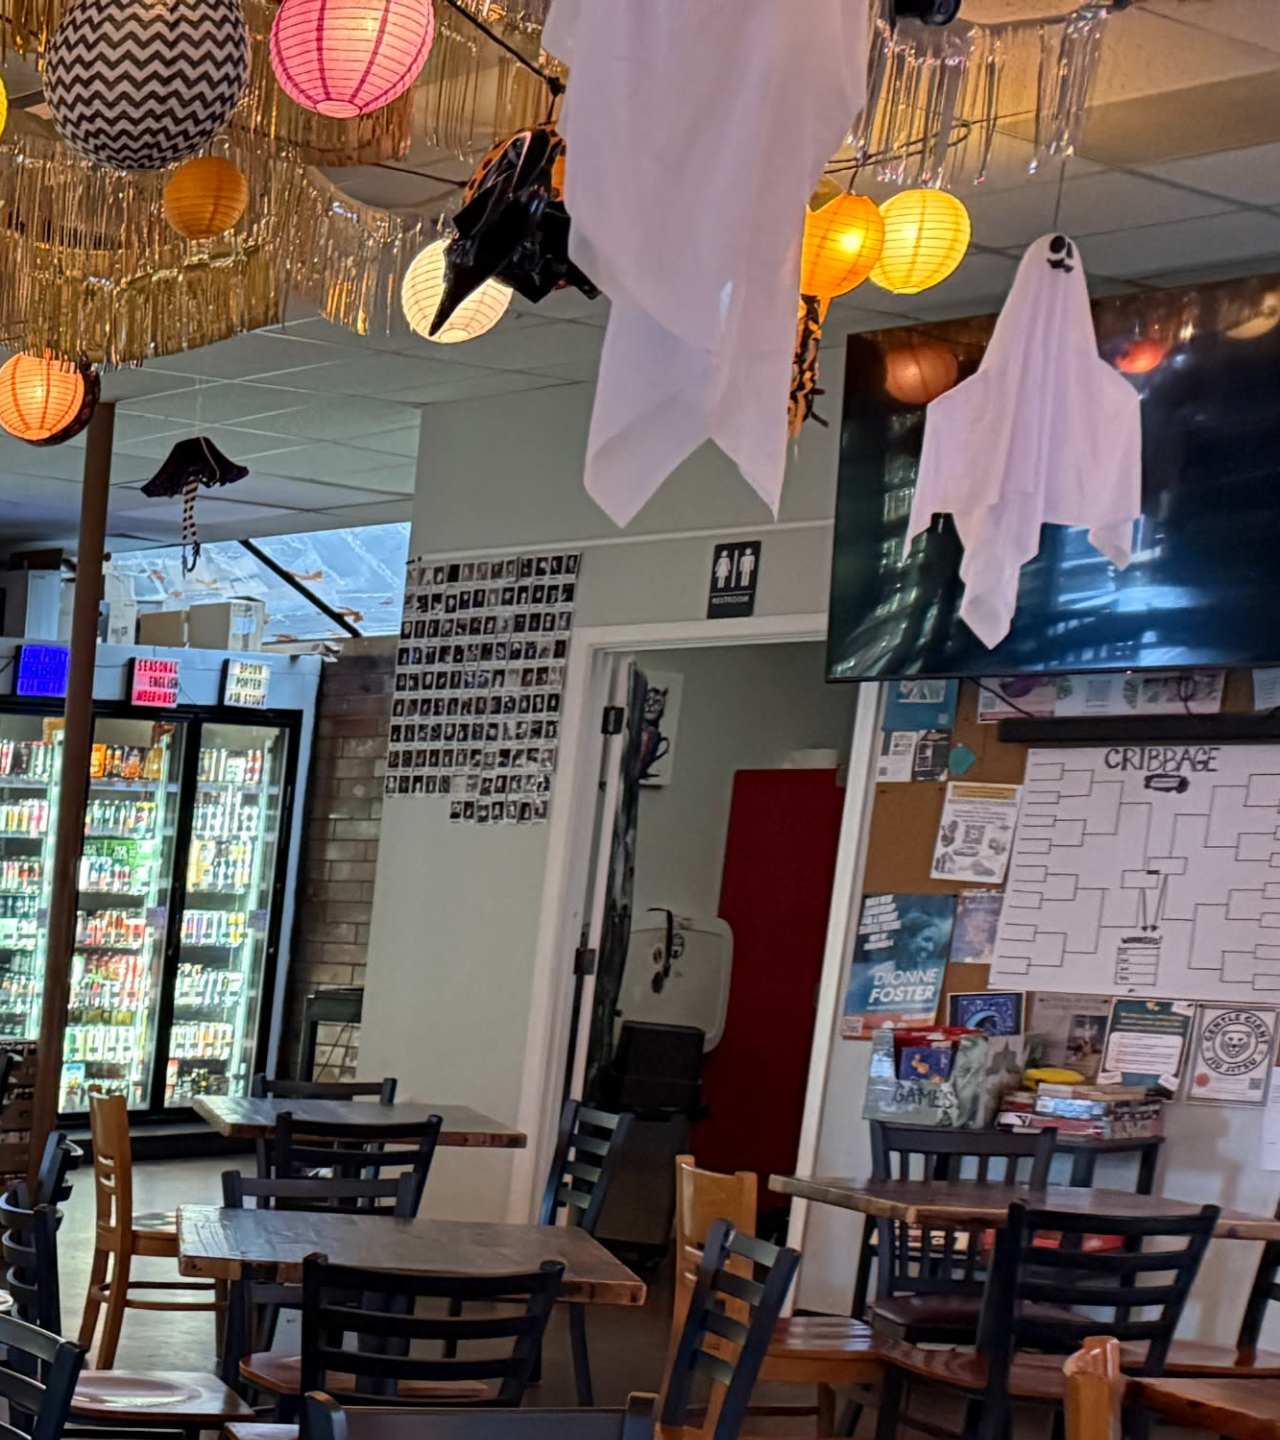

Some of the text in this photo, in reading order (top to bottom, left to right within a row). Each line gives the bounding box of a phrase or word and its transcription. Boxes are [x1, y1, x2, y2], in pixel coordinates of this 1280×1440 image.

[137, 659, 178, 674] SEASONAL
[149, 676, 178, 690] ENGLISH
[1103, 747, 1222, 773] CRIBBAGE
[872, 967, 939, 986] DIONNE
[868, 985, 936, 1004] FOSTER
[1203, 1013, 1242, 1042] GENTLE
[1244, 1015, 1269, 1044] GIANT
[894, 1082, 954, 1110] GAMES
